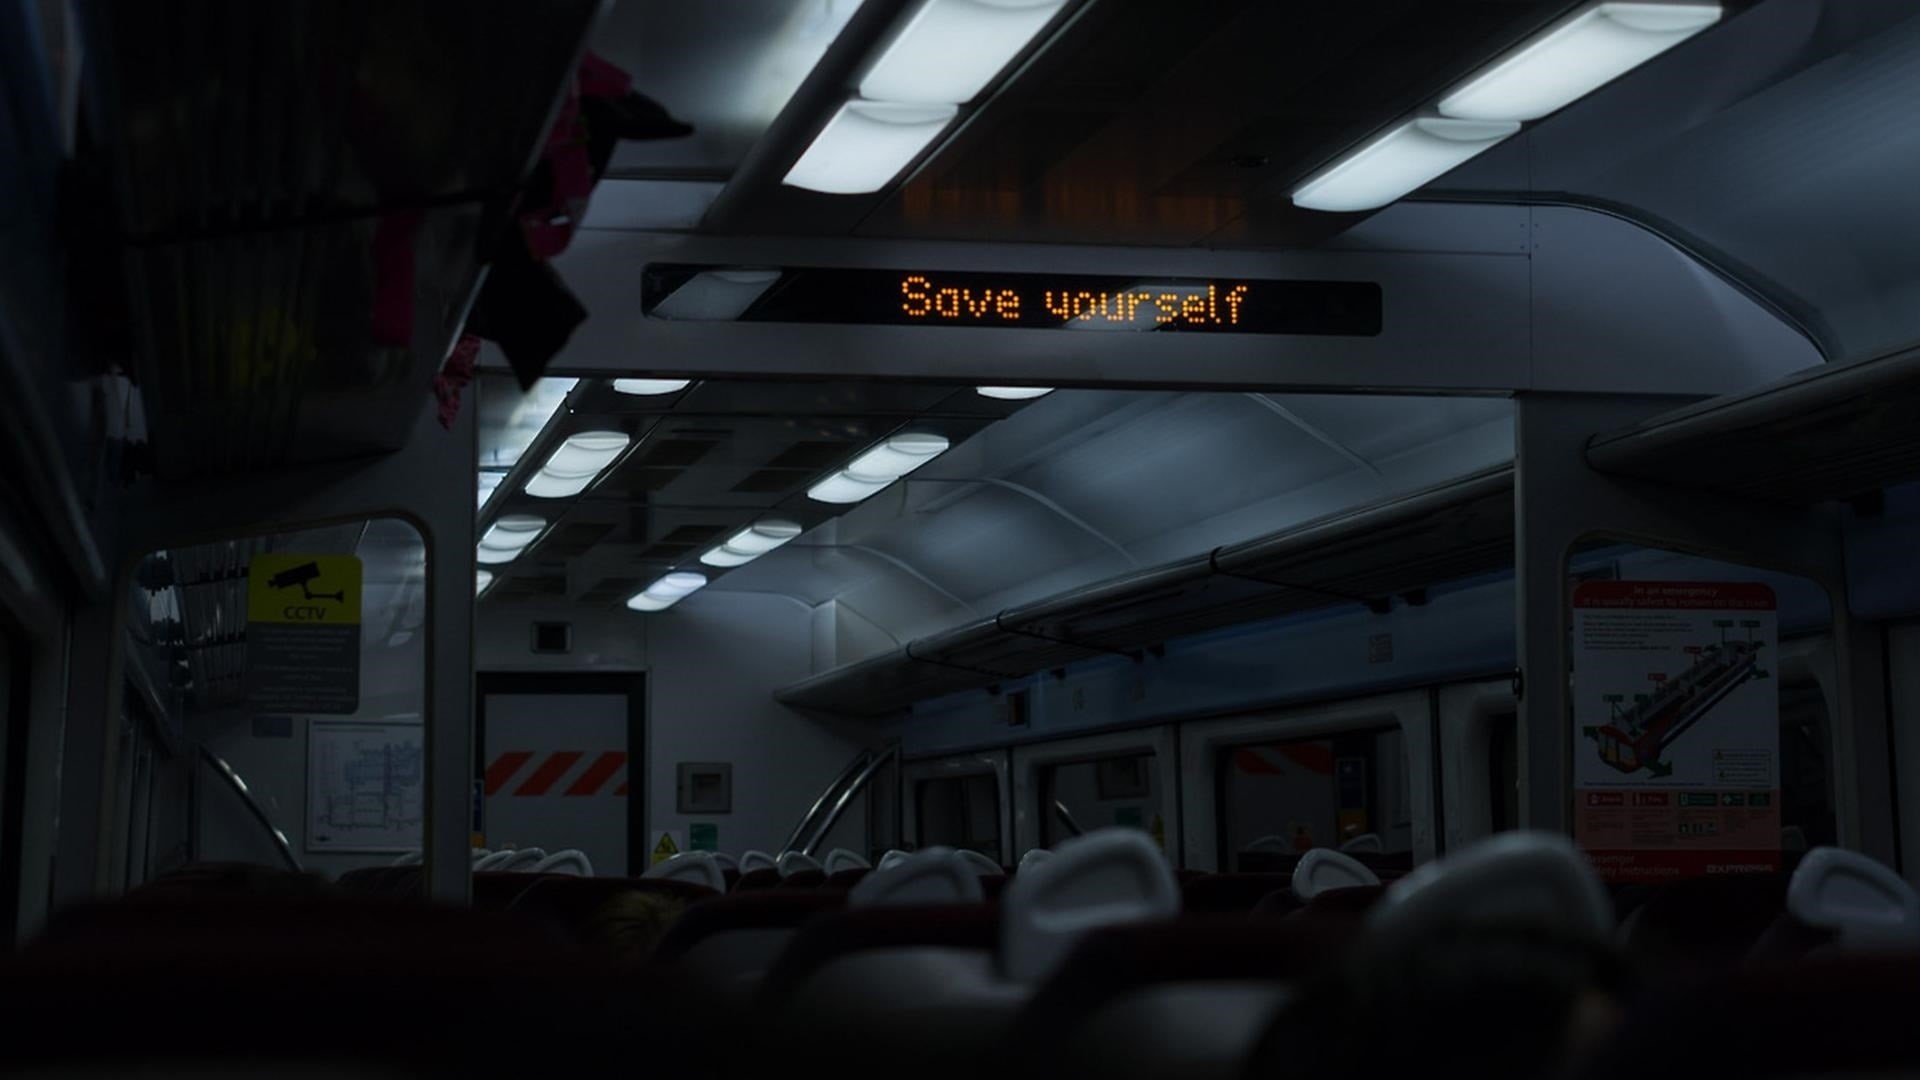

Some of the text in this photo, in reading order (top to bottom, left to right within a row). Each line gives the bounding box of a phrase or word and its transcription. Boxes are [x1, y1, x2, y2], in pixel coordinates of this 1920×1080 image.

[901, 275, 1248, 325] Save yourself
[283, 606, 326, 620] CCTV
